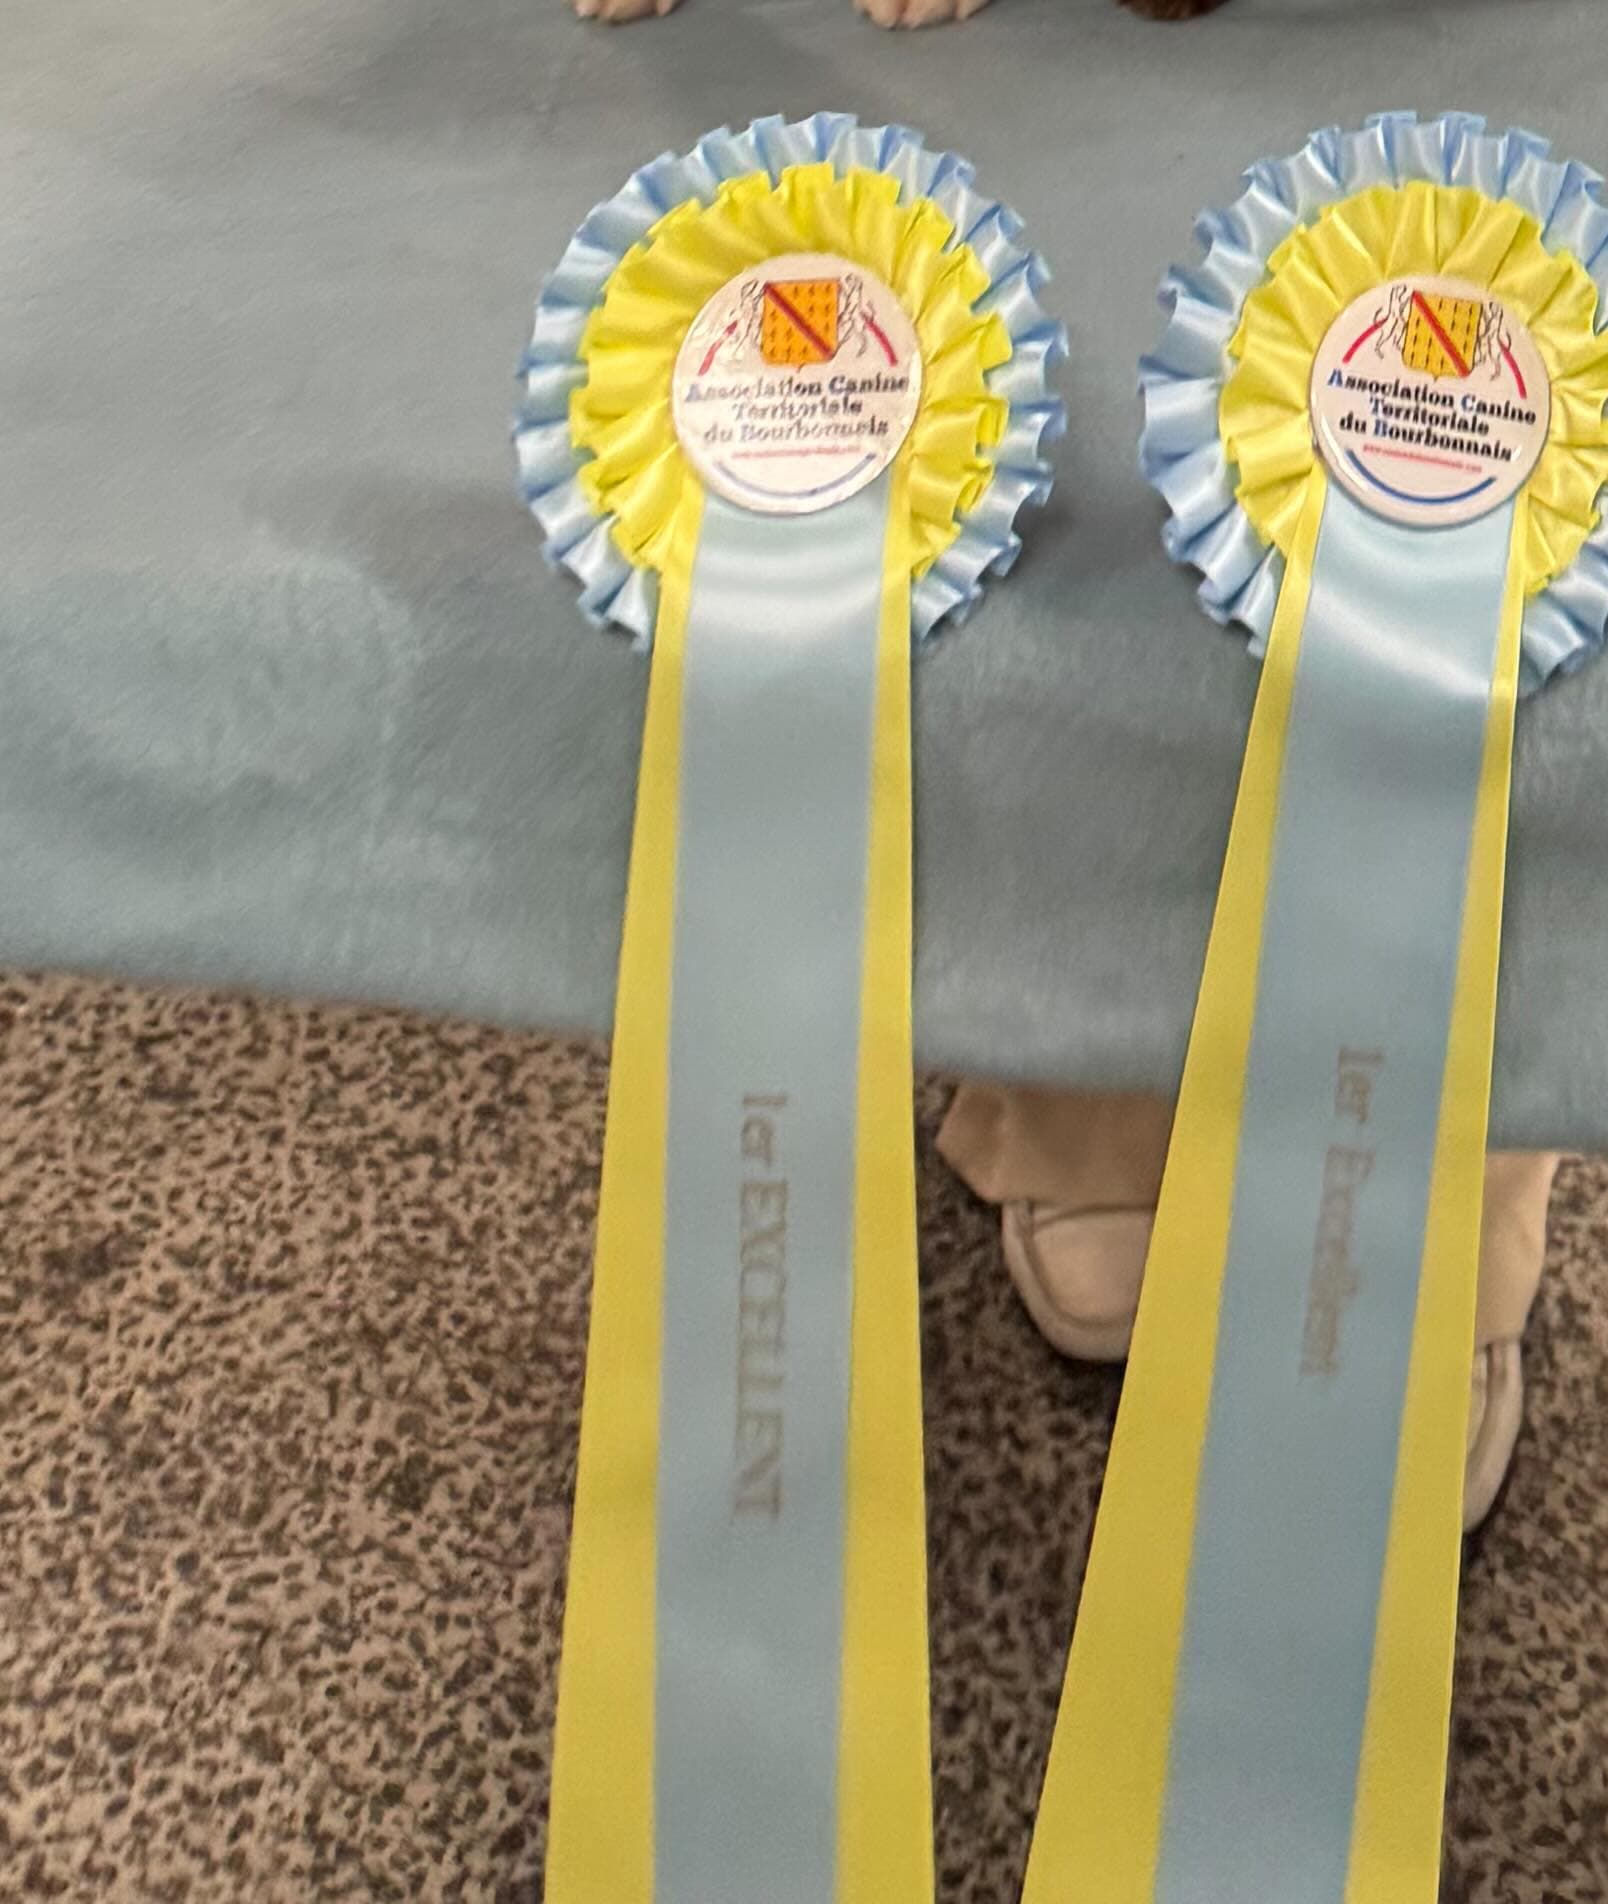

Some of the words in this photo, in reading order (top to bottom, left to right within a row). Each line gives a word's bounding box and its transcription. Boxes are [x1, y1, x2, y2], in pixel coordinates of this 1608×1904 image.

[828, 371, 908, 396] Canine
[1327, 368, 1455, 409] Association
[1461, 394, 1537, 426] Canine
[703, 422, 733, 443] du
[1339, 411, 1367, 434] du
[1374, 418, 1513, 462] Bourbonnais
[1369, 396, 1490, 437] Territoriale
[740, 1094, 789, 1170] 1er
[732, 1179, 789, 1525] EXCELLENT
